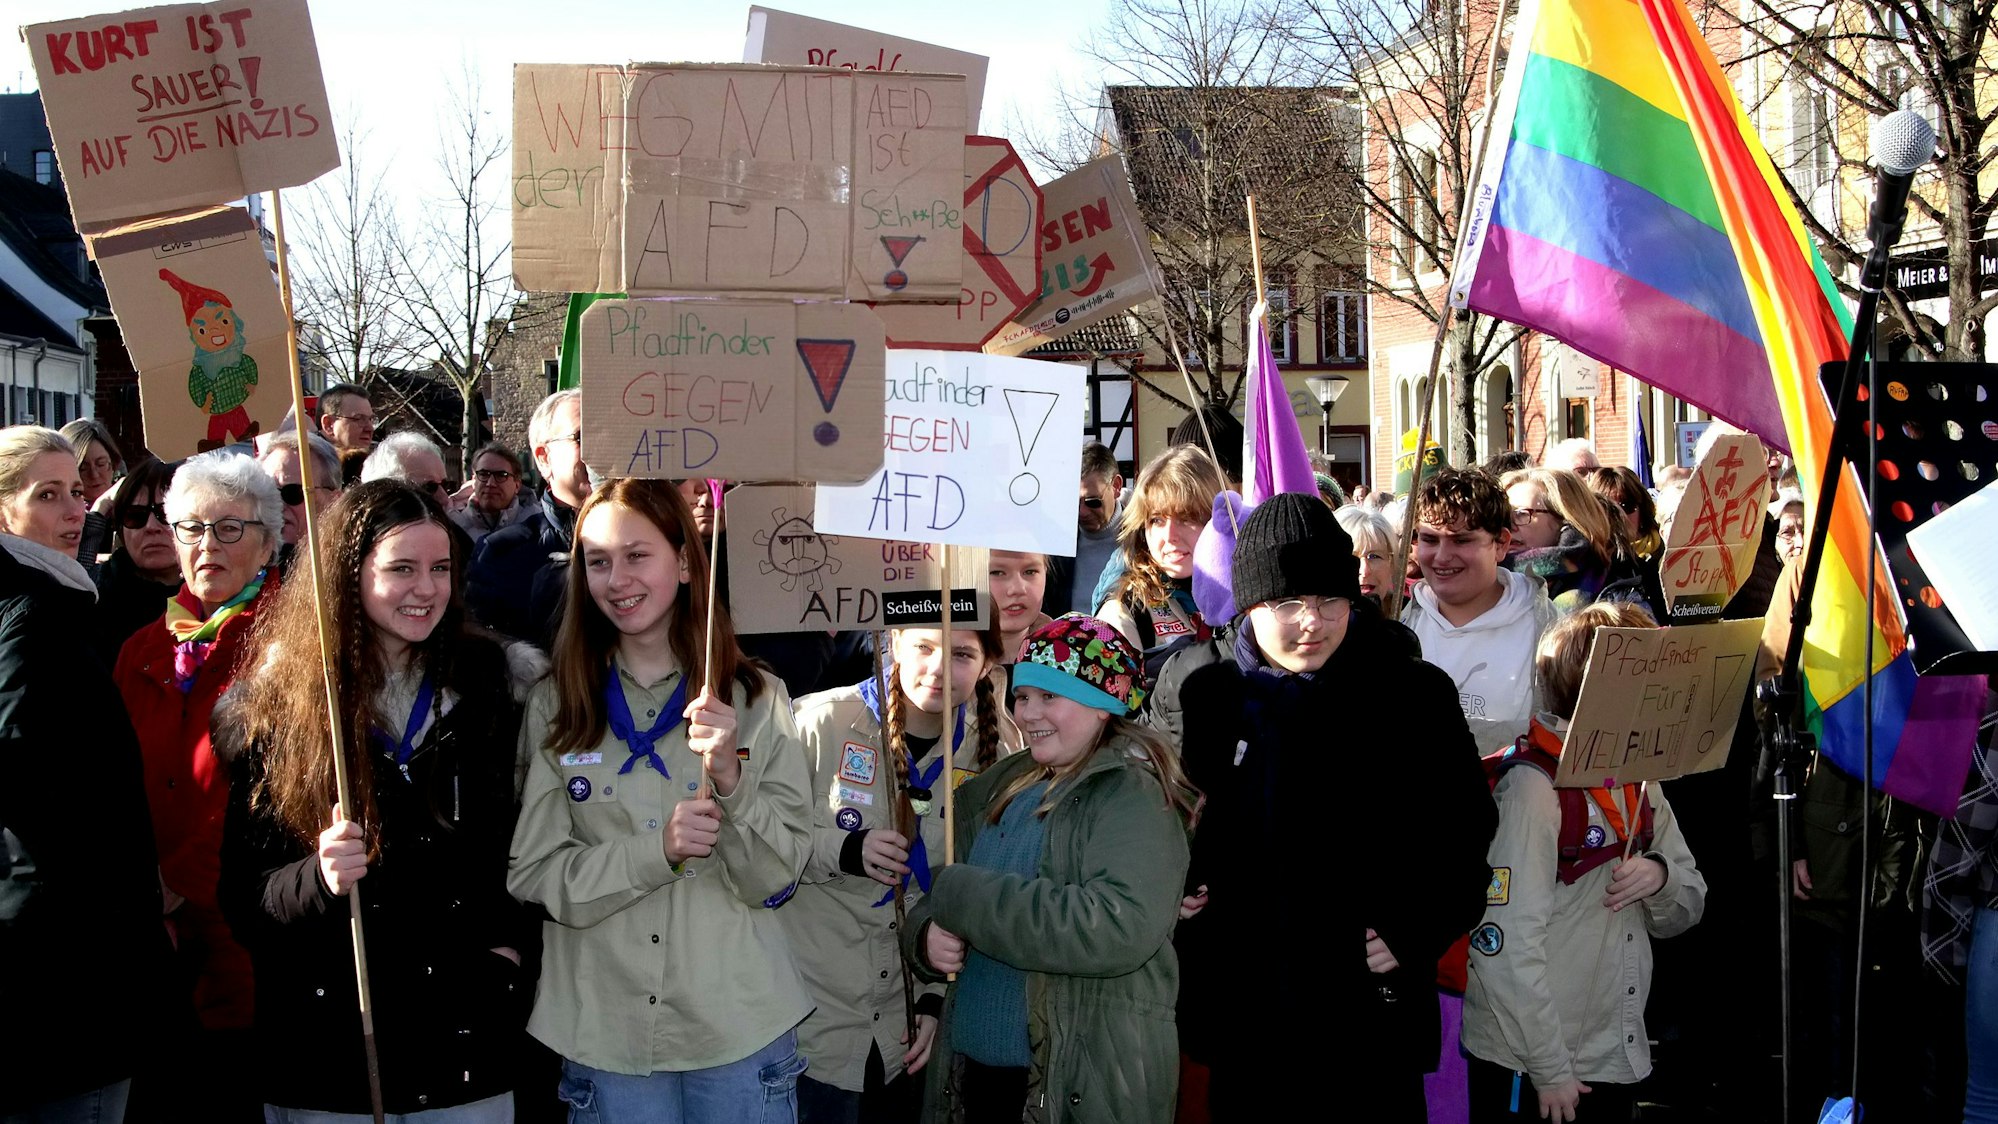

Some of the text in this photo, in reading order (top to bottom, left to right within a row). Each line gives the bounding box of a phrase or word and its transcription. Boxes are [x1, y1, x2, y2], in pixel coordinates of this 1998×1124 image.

[46, 8, 253, 76] KURT IST
[531, 67, 852, 162] WEG MIT
[866, 84, 932, 129] AFD
[81, 103, 320, 179] AUF DIE NAZIS
[513, 151, 603, 209] der
[634, 200, 809, 288] AFD
[1042, 196, 1113, 252] SEN
[1897, 267, 1936, 288] MEIER
[1938, 266, 1949, 282] &
[607, 306, 775, 359] Pfadfinder
[622, 371, 774, 426] GEGEN
[885, 361, 993, 407] adfinder
[627, 428, 719, 474] AFD
[868, 470, 965, 532] AFD
[1689, 499, 1759, 543] AFD
[882, 540, 935, 563] ÜBER
[884, 567, 916, 581] DIE
[799, 587, 878, 624] AFD
[886, 598, 975, 615] Scheißvrein
[1600, 633, 1707, 676] Pfadfinder
[1638, 684, 1682, 717] Für
